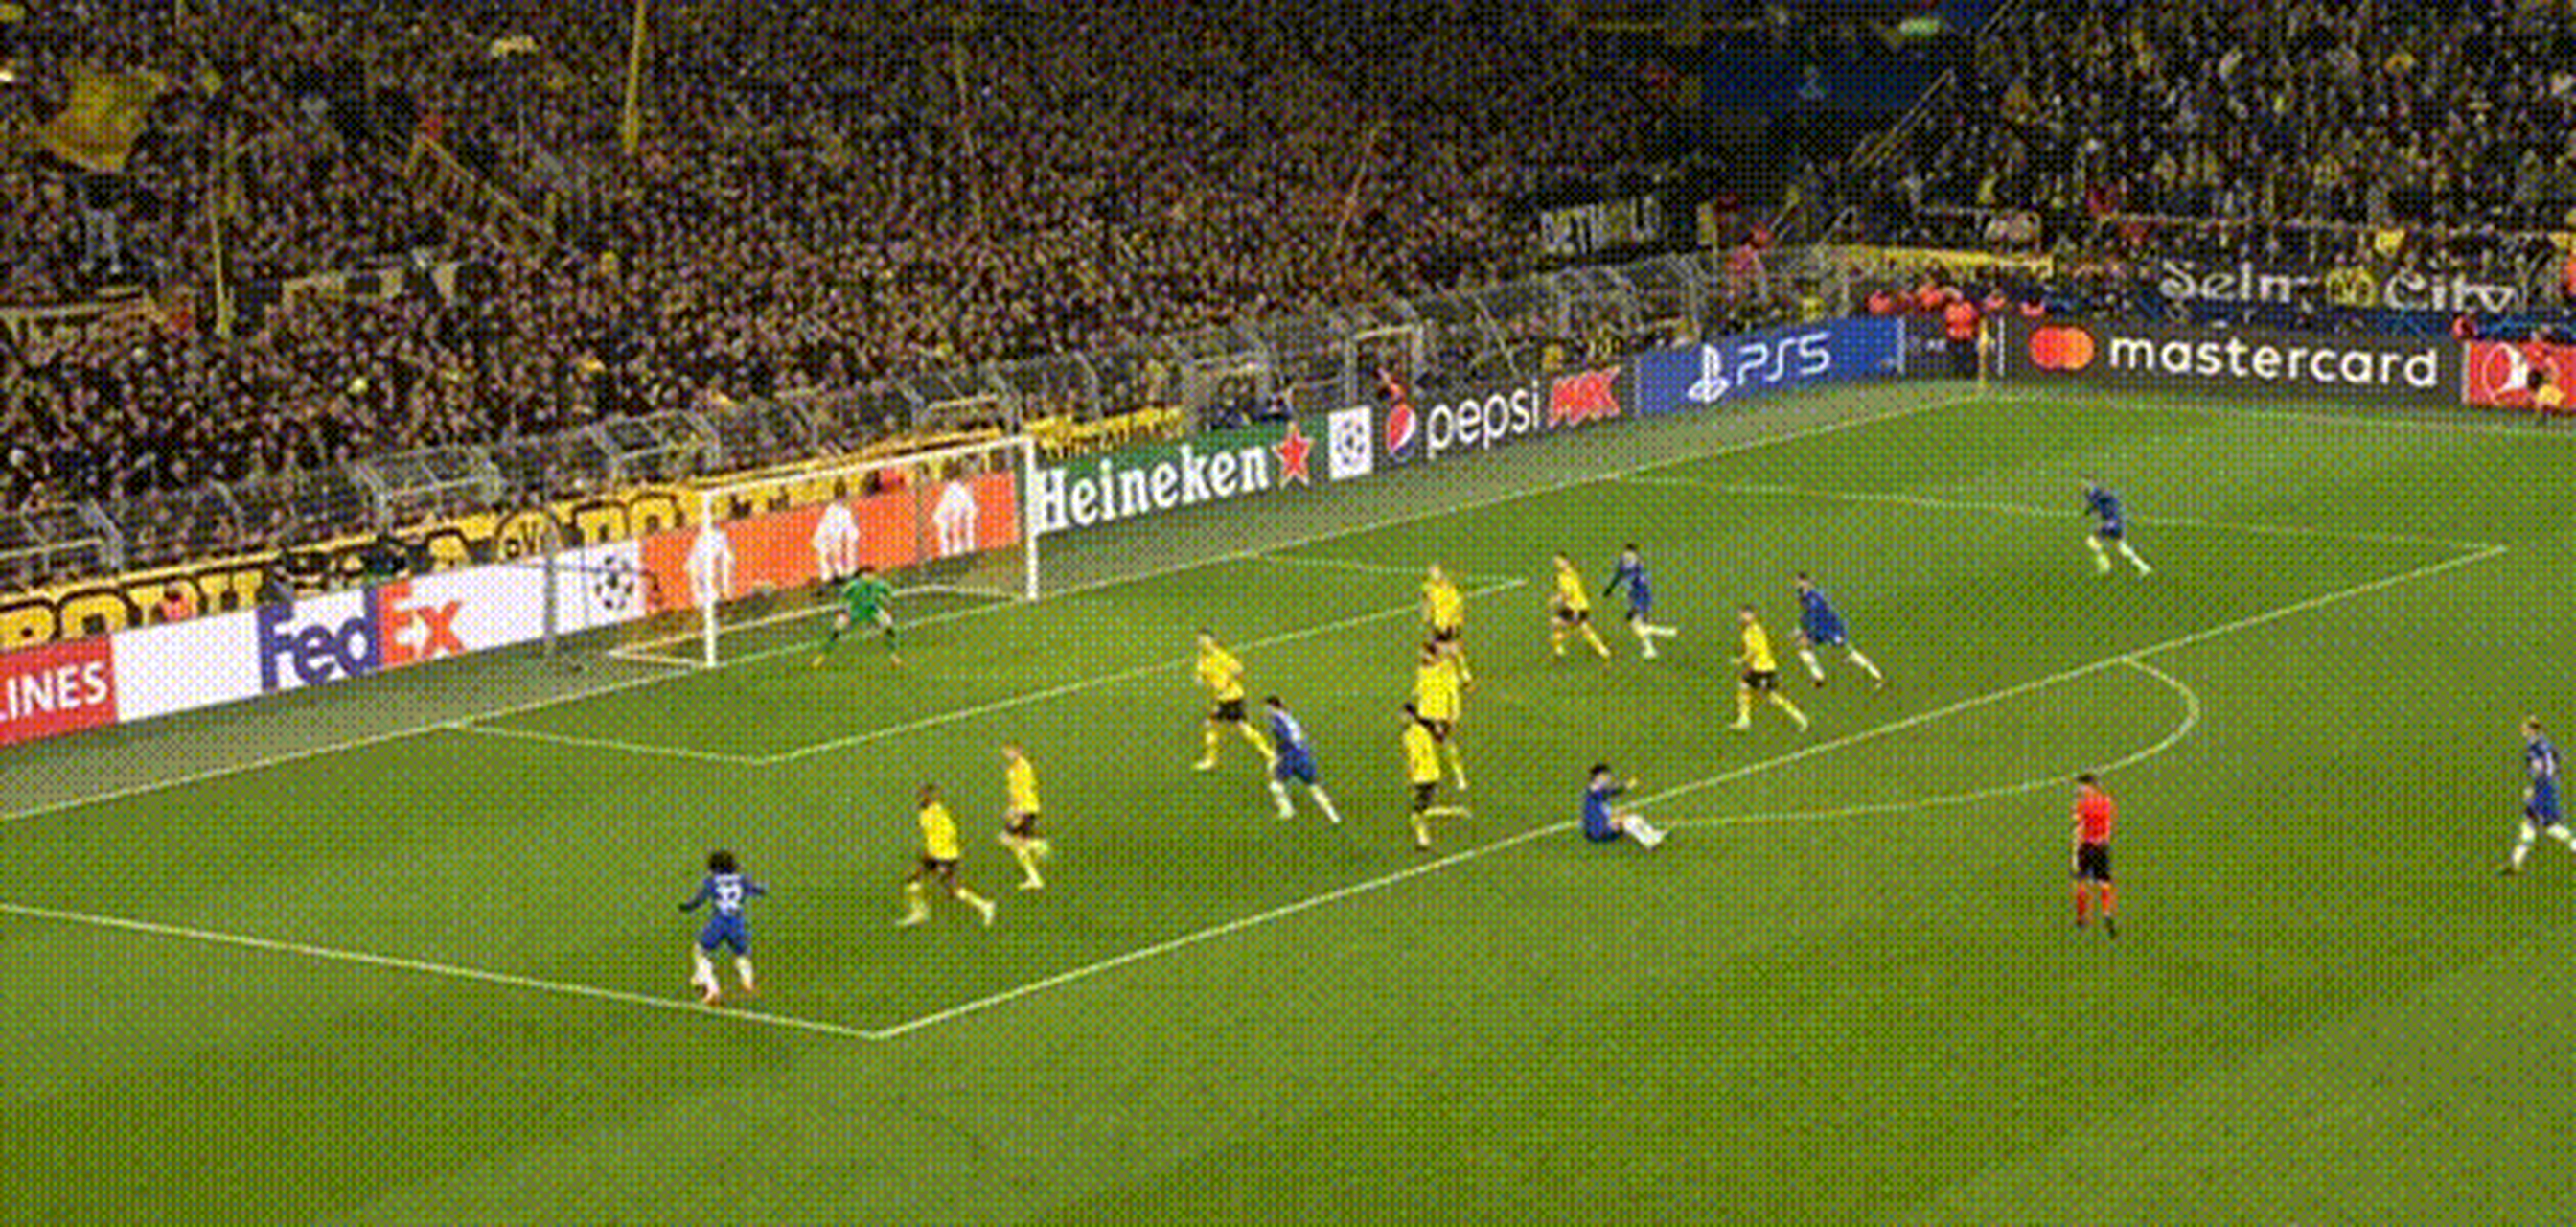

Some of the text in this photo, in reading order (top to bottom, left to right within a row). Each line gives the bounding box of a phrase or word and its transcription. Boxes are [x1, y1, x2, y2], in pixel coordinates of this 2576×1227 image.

[1736, 332, 1831, 385] PS5
[2109, 336, 2437, 388] mastercard
[1427, 381, 1540, 459] pepsi
[1031, 444, 1270, 533] Heineken
[256, 576, 465, 691] FedEx
[0, 660, 108, 721] INES
